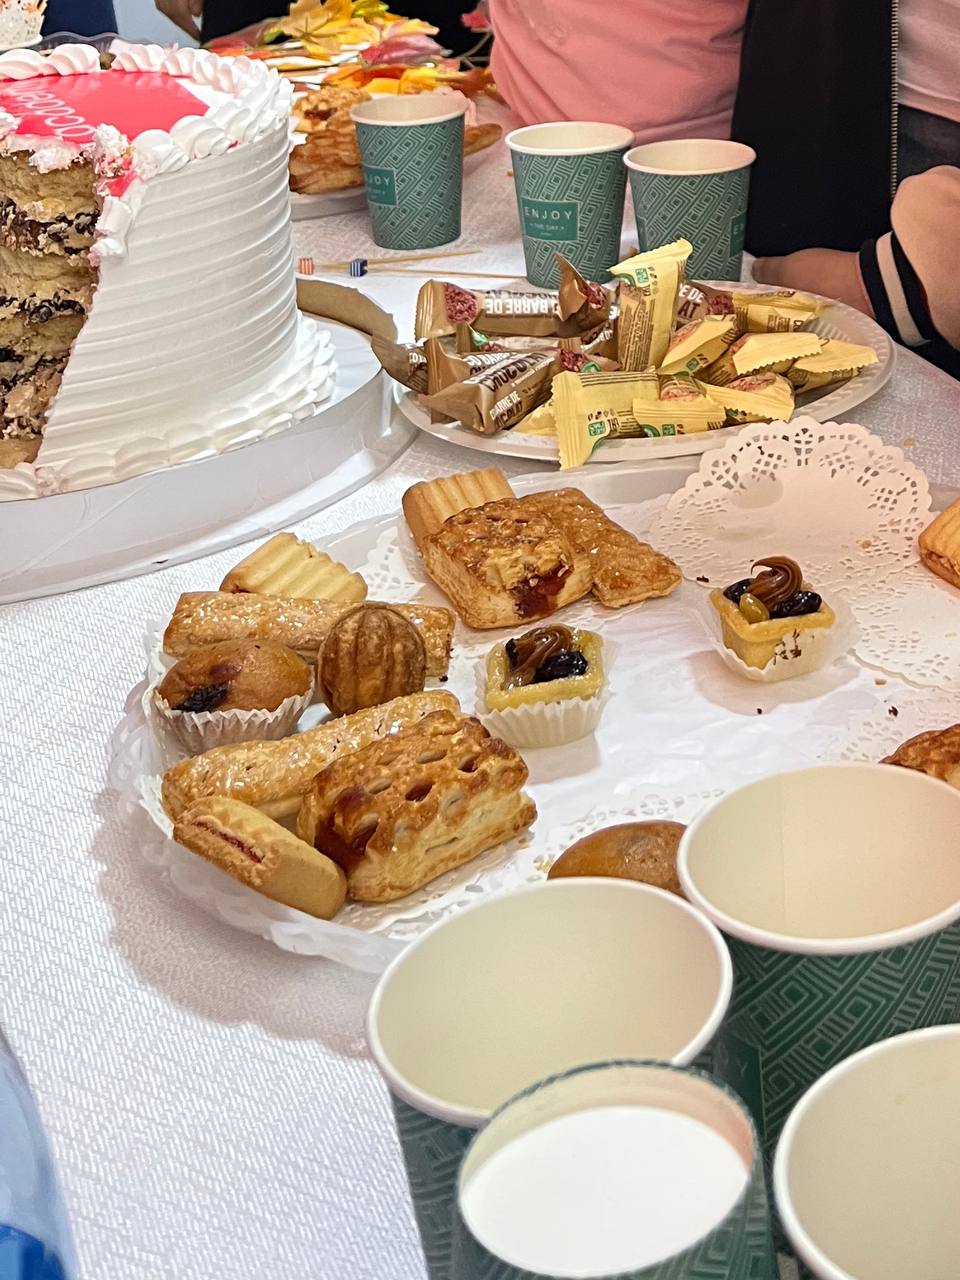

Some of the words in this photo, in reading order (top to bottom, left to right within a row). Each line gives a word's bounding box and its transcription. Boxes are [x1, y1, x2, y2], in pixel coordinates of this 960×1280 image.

[524, 206, 573, 221] ENJOY
[687, 288, 706, 303] DE
[485, 299, 503, 314] DE
[505, 299, 548, 314] BARRE
